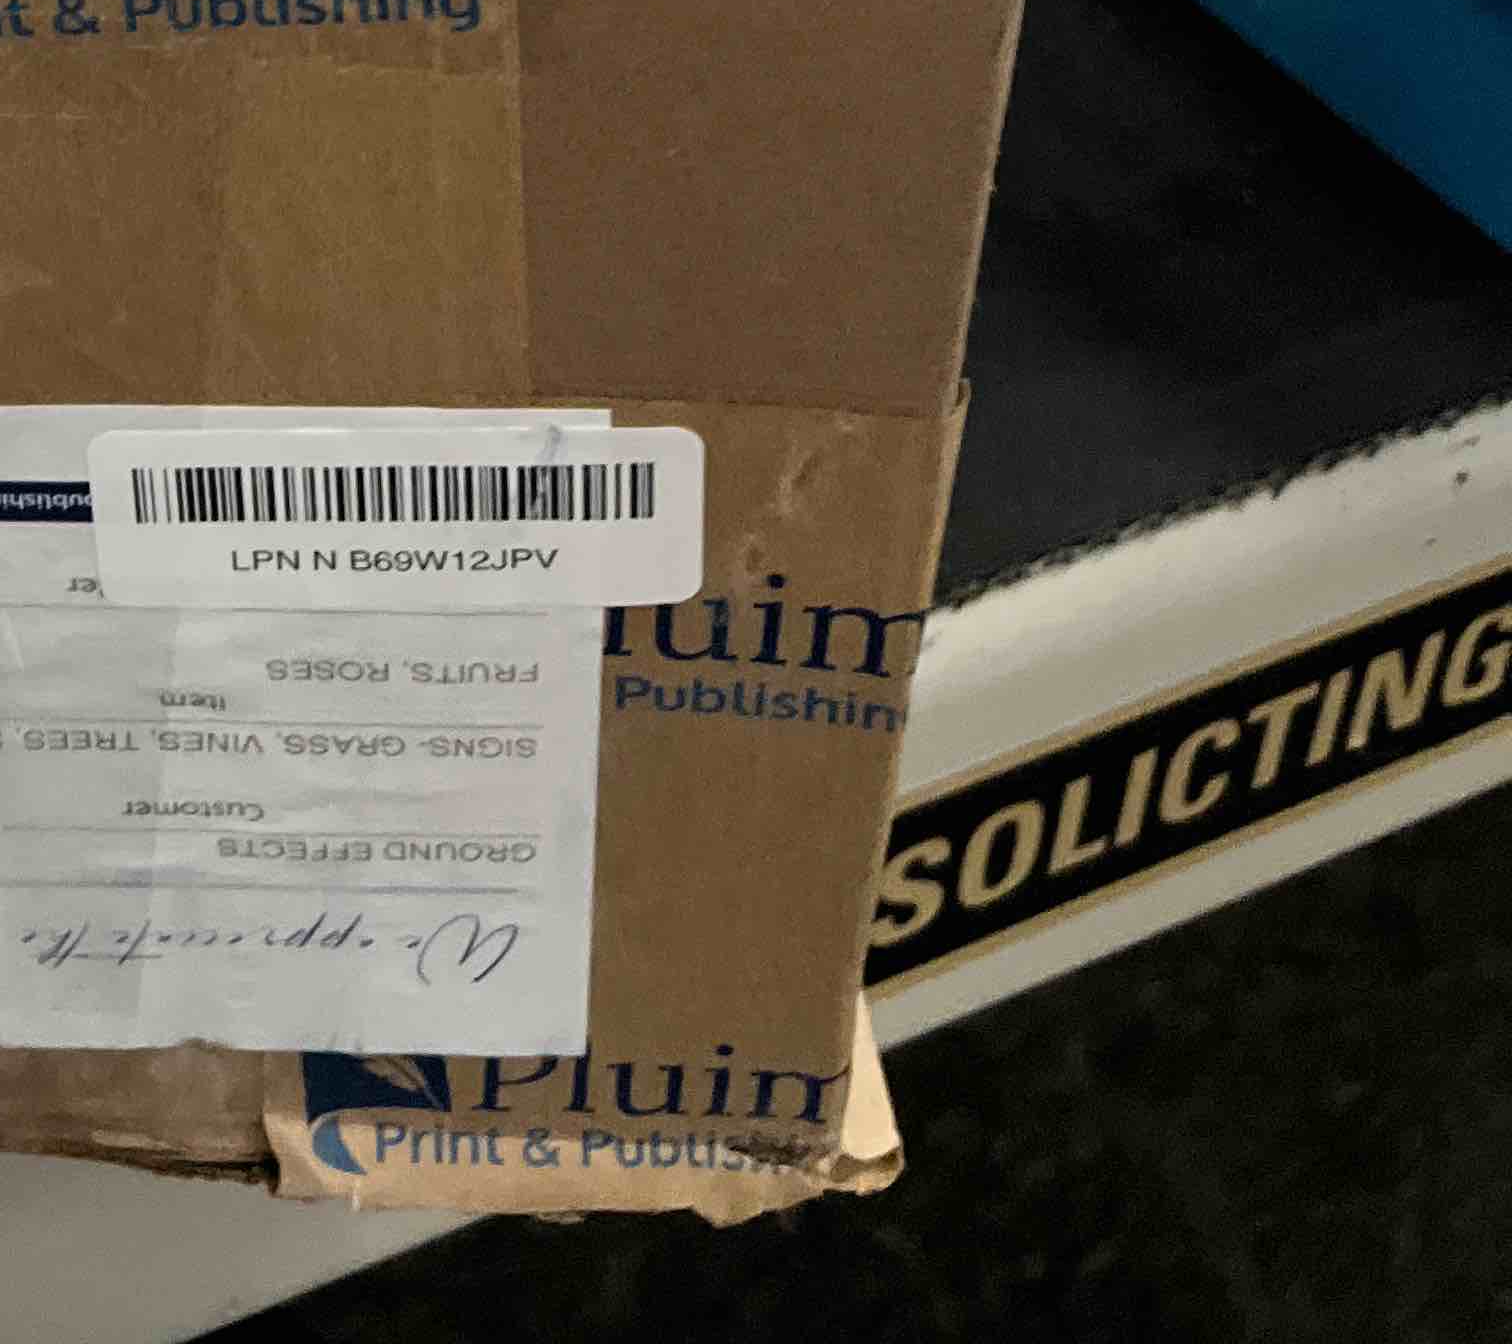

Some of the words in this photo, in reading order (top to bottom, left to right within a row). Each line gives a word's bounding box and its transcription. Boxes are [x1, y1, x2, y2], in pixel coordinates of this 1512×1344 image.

[232, 549, 303, 572] LPN
[313, 549, 336, 572] N
[350, 548, 558, 572] B69W12JPV
[264, 659, 390, 684] ROSES
[402, 660, 539, 685] FRUITS,
[14, 726, 140, 752] TREES,
[149, 727, 264, 753] VINES,
[275, 730, 406, 757] GRASS,
[870, 606, 1512, 949] SOLICTING
[121, 800, 265, 823] Customer
[216, 837, 372, 861] EFFECTS
[383, 840, 537, 863] GROUND
[19, 921, 93, 968] the
[114, 914, 375, 967] appreciate
[398, 914, 519, 985] We
[375, 1121, 503, 1167] Print
[522, 1128, 560, 1169] &
